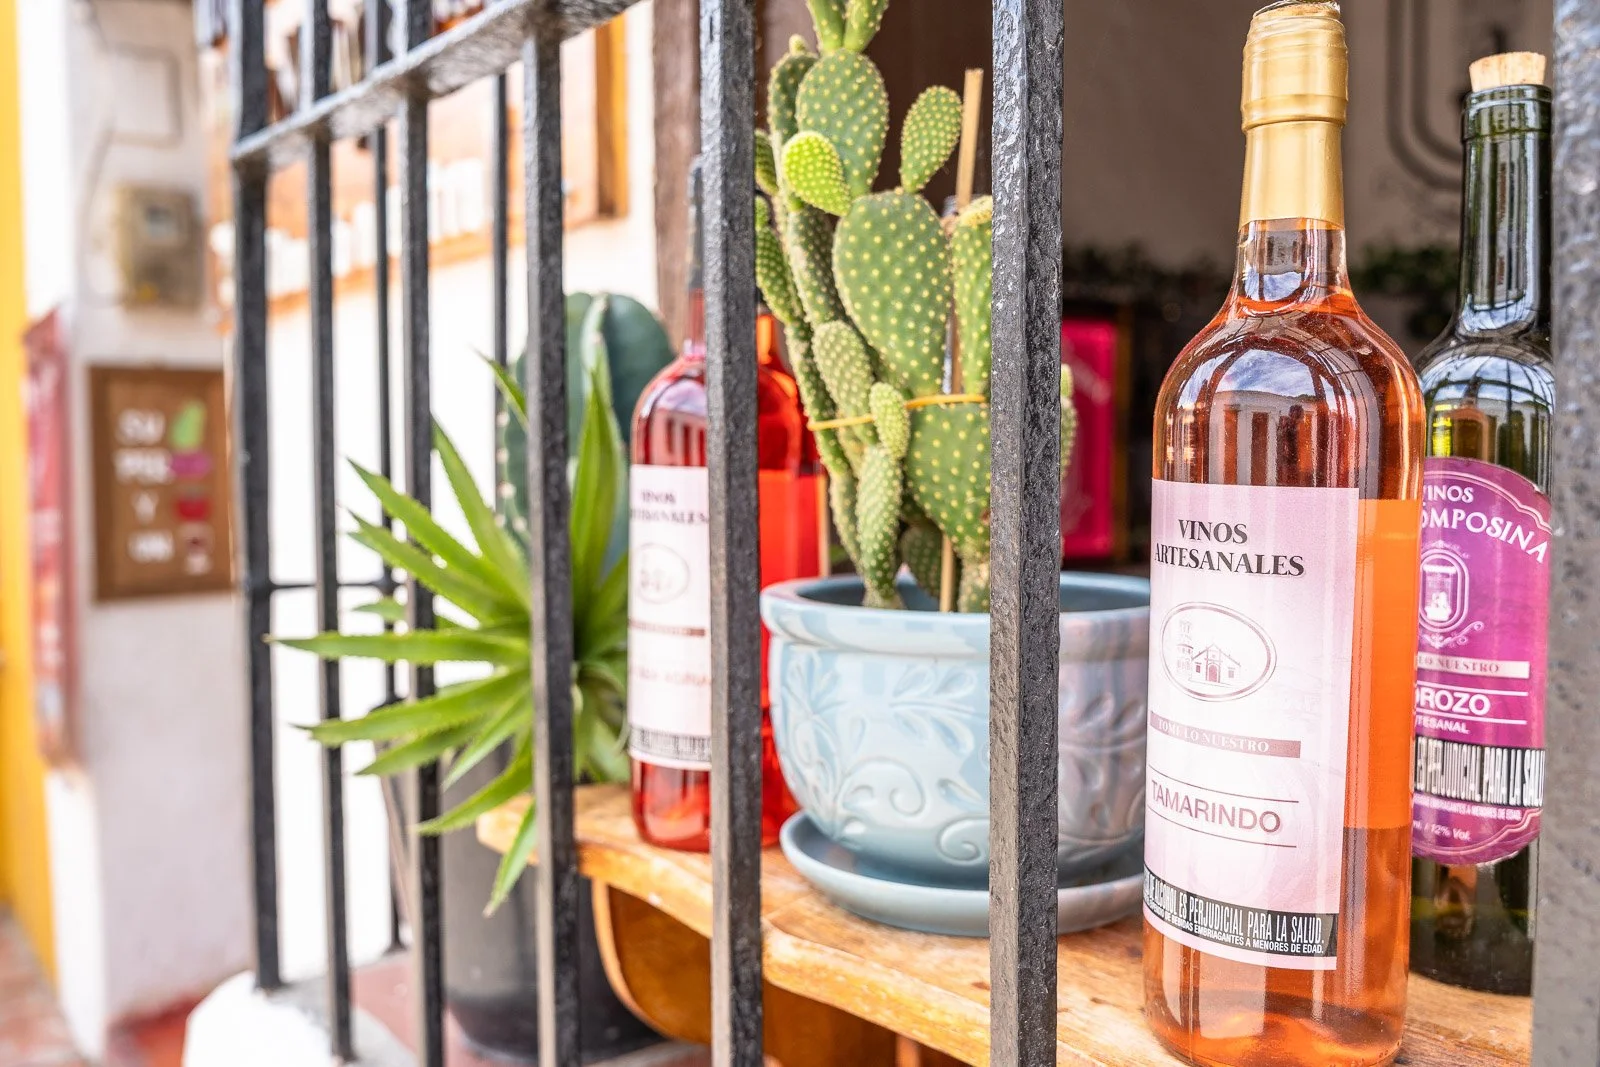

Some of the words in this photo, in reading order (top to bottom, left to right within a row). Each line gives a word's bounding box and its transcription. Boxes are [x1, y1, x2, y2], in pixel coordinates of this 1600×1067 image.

[1178, 519, 1248, 544] VINOS
[1421, 503, 1548, 564] MPOSINA
[1154, 542, 1305, 577] ARTESANALES
[1438, 658, 1499, 673] NUESTRO
[1416, 686, 1491, 716] ROZO
[1416, 714, 1470, 734] TESANAL
[1184, 728, 1199, 741] LO
[1202, 732, 1270, 753] NUESTRO
[1509, 748, 1522, 806] LA
[1151, 779, 1281, 833] TAMARINDO
[1179, 890, 1188, 920] ES
[1188, 895, 1244, 936] PERJUDICIAL
[1247, 910, 1272, 941] PARA
[1275, 914, 1288, 942] LA
[1291, 915, 1325, 944] SALUD.
[1194, 924, 1245, 946] EMBRIAGANTES
[1245, 938, 1251, 947] A
[1253, 939, 1289, 953] MENORES
[1290, 943, 1301, 953] DE
[1303, 944, 1324, 953] EDAD.
